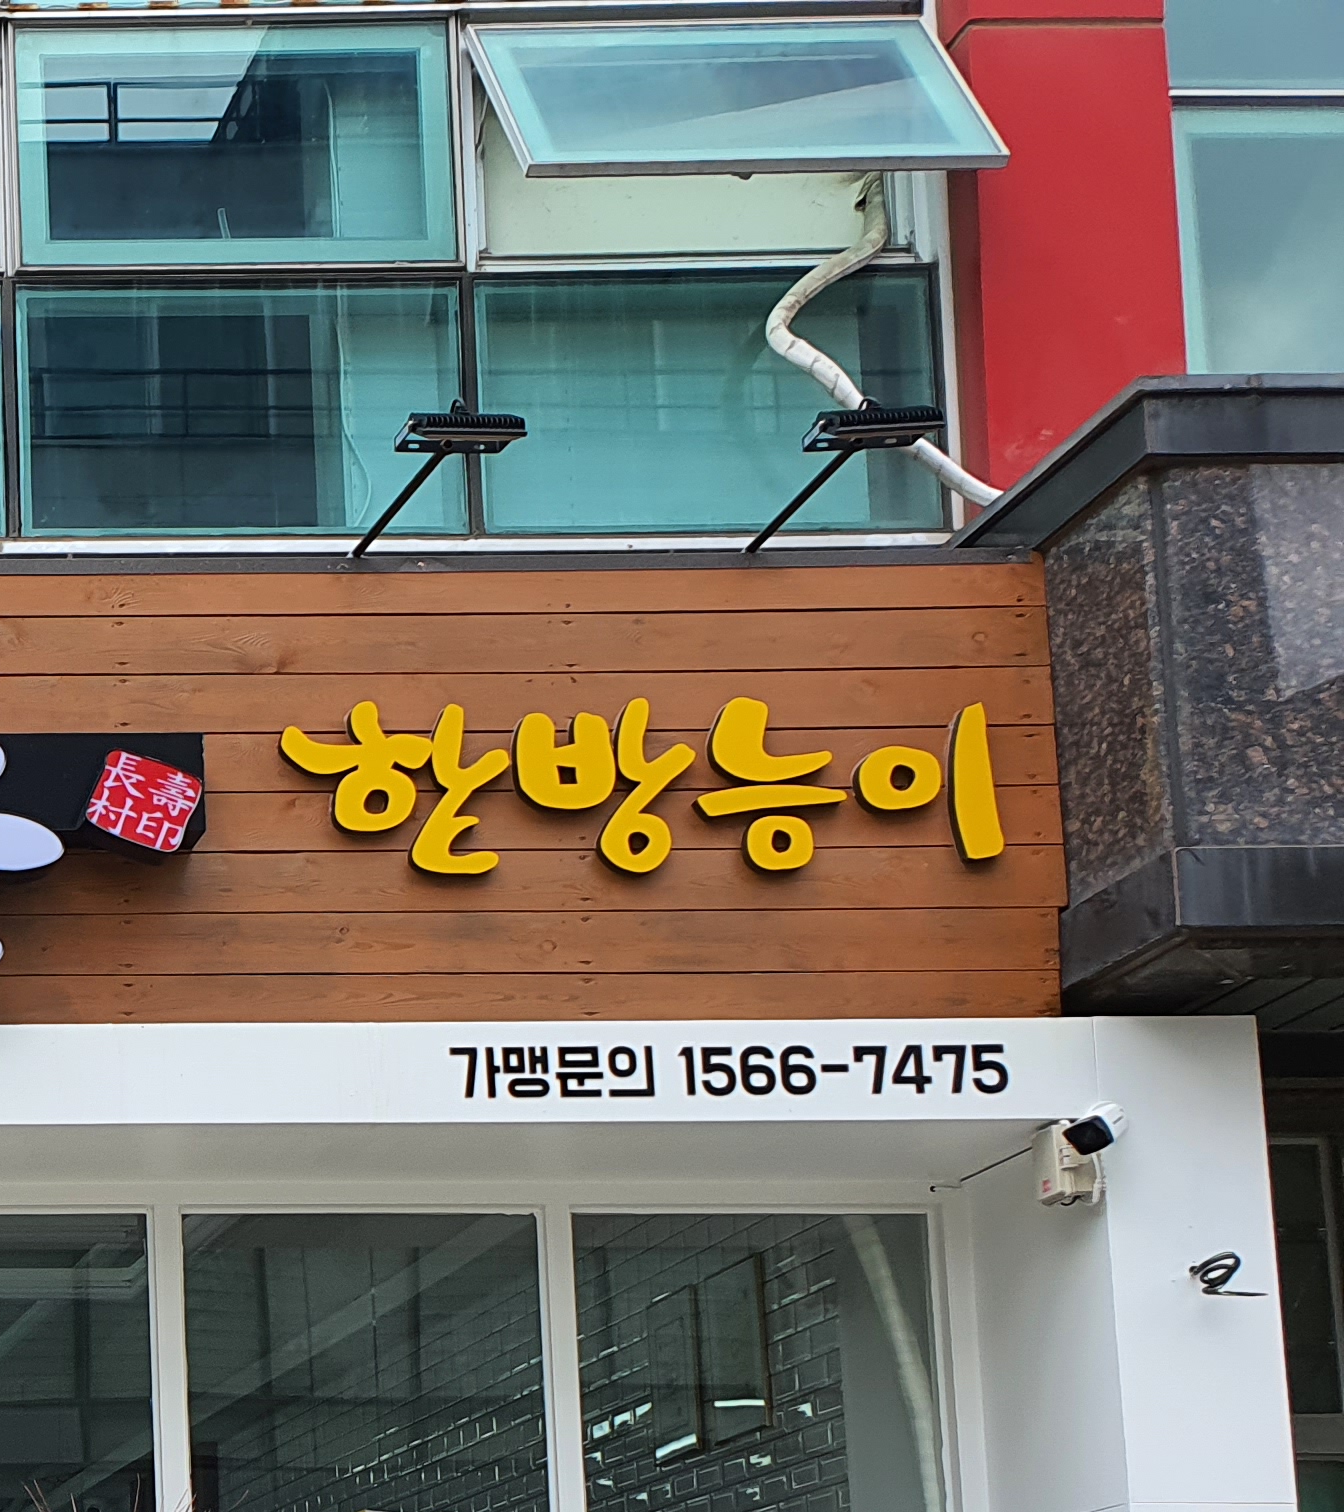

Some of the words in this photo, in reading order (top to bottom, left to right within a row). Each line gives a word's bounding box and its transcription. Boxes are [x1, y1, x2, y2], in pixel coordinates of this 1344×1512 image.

[279, 697, 1006, 876] 한방능이
[448, 1044, 655, 1099] 가맹문의
[678, 1043, 1010, 1096] 1566-7475
